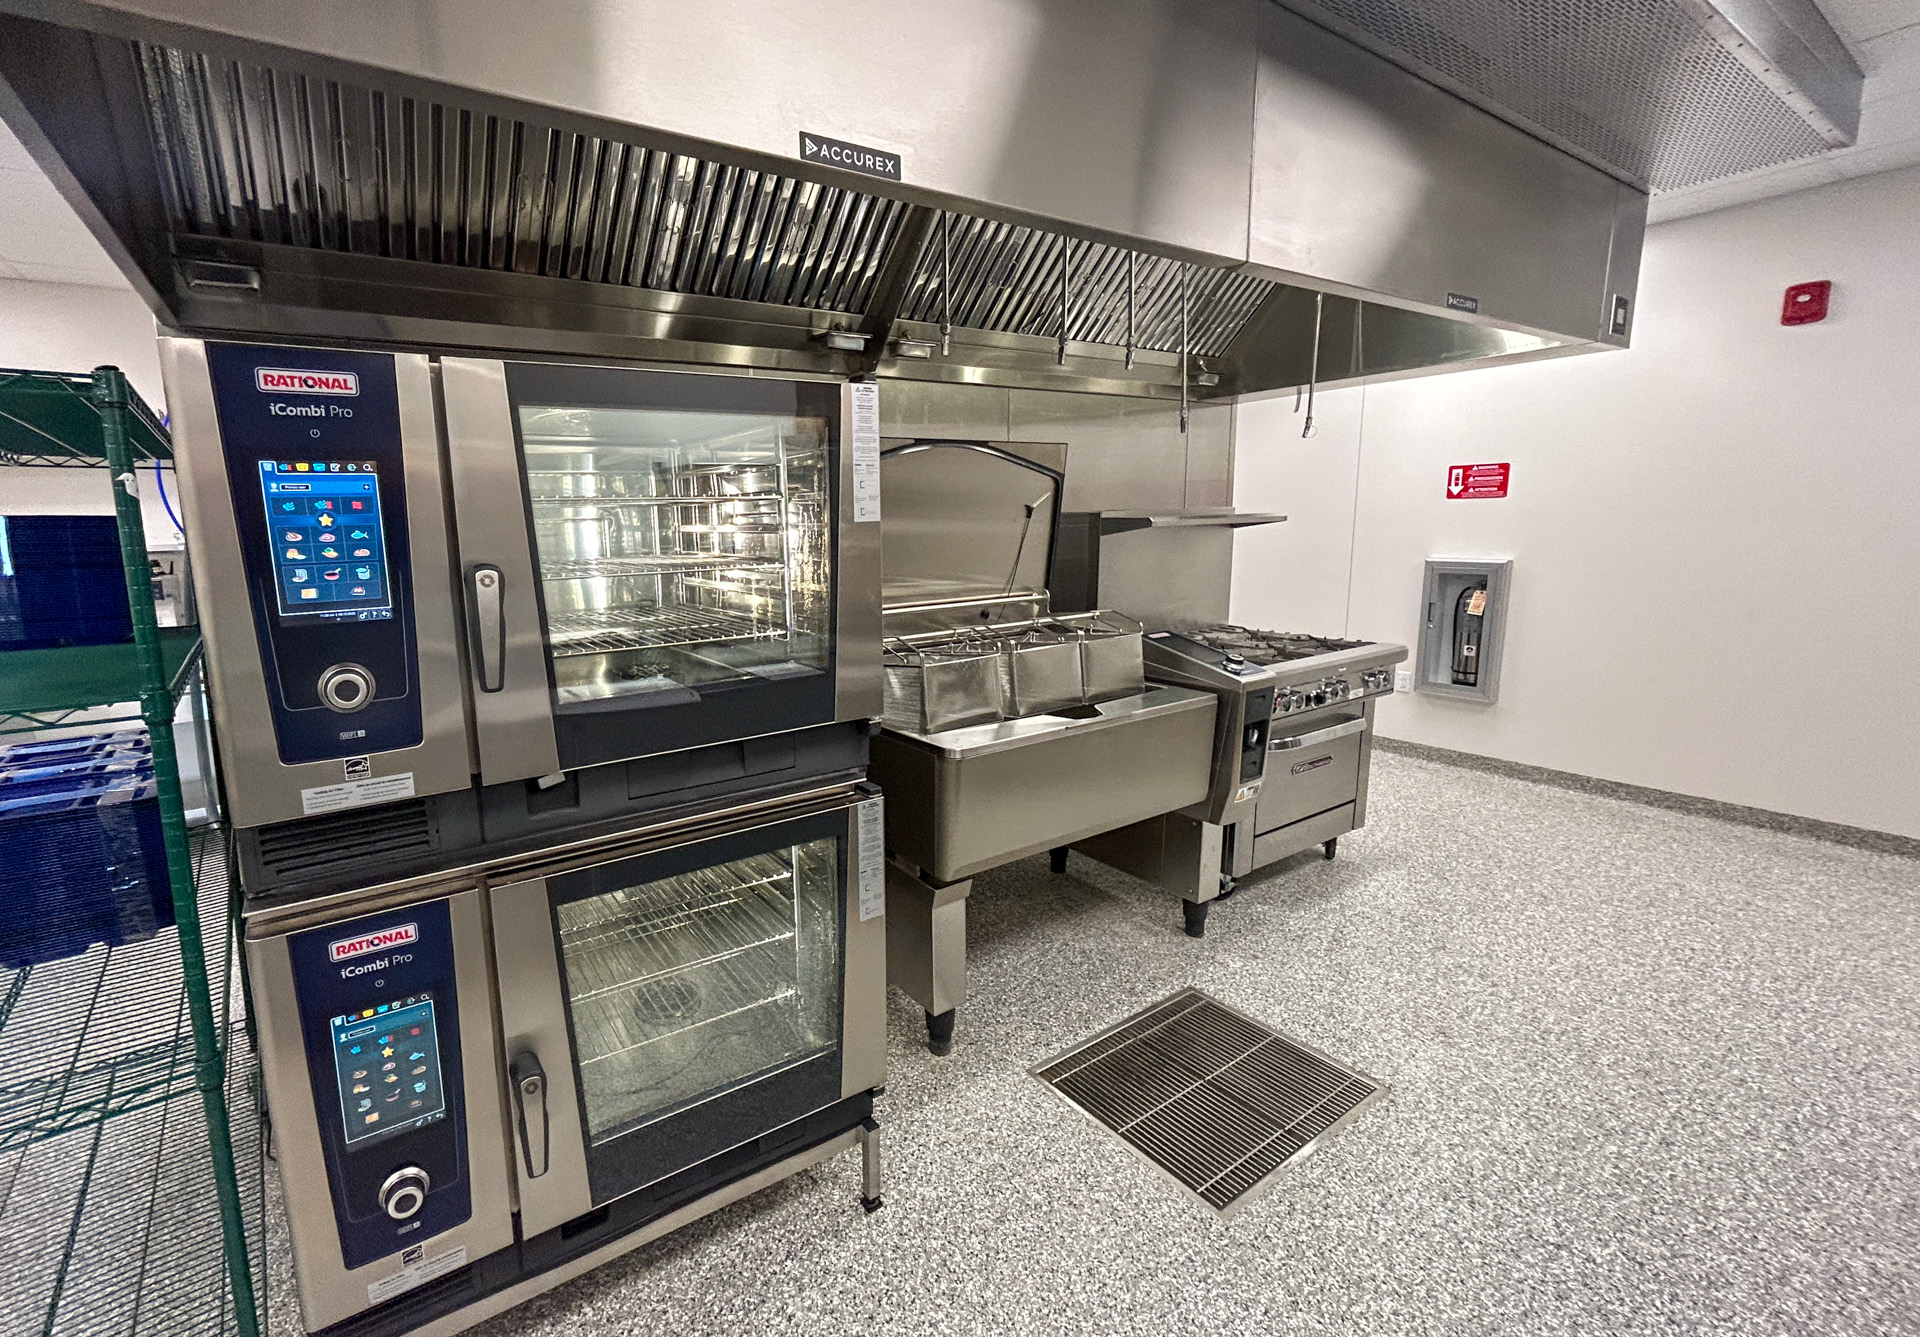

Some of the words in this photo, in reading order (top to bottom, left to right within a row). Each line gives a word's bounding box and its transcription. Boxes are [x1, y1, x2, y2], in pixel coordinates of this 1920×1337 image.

[820, 144, 895, 173] ACCUREX
[263, 374, 353, 390] RATIONAL
[269, 403, 326, 417] iCombi
[330, 405, 353, 418] Pro
[336, 930, 413, 956] RATIONAL
[340, 958, 389, 979] iCombi
[393, 954, 413, 966] Pro
